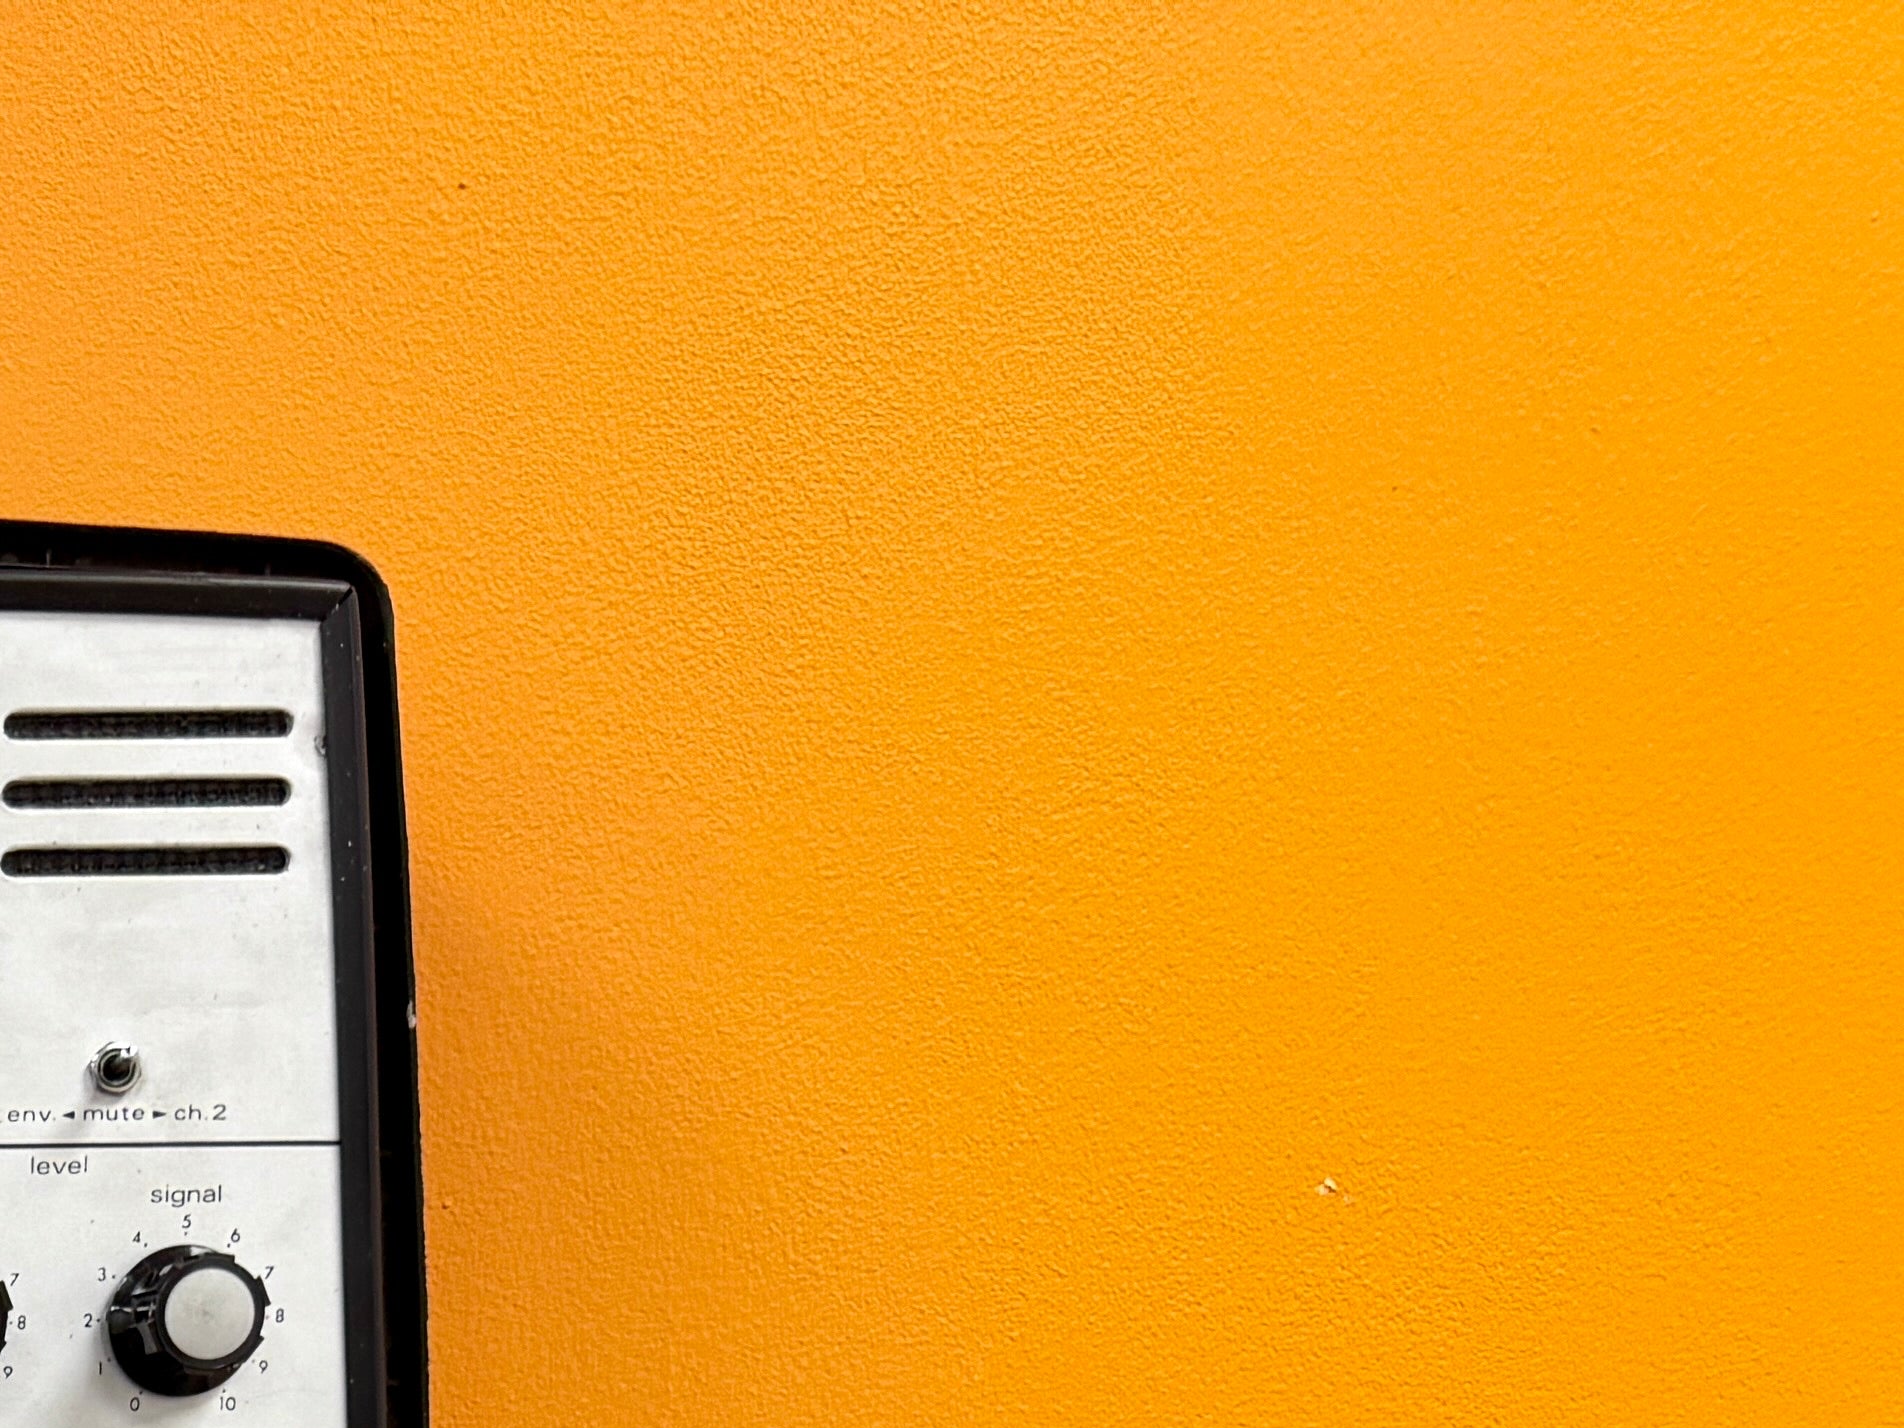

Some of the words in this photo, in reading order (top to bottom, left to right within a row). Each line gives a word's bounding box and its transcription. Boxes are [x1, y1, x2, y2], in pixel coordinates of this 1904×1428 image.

[8, 1108, 57, 1124] env.
[84, 1108, 144, 1120] mute
[175, 1105, 226, 1120] ch.2
[31, 1156, 87, 1174] level
[151, 1185, 221, 1207] signal
